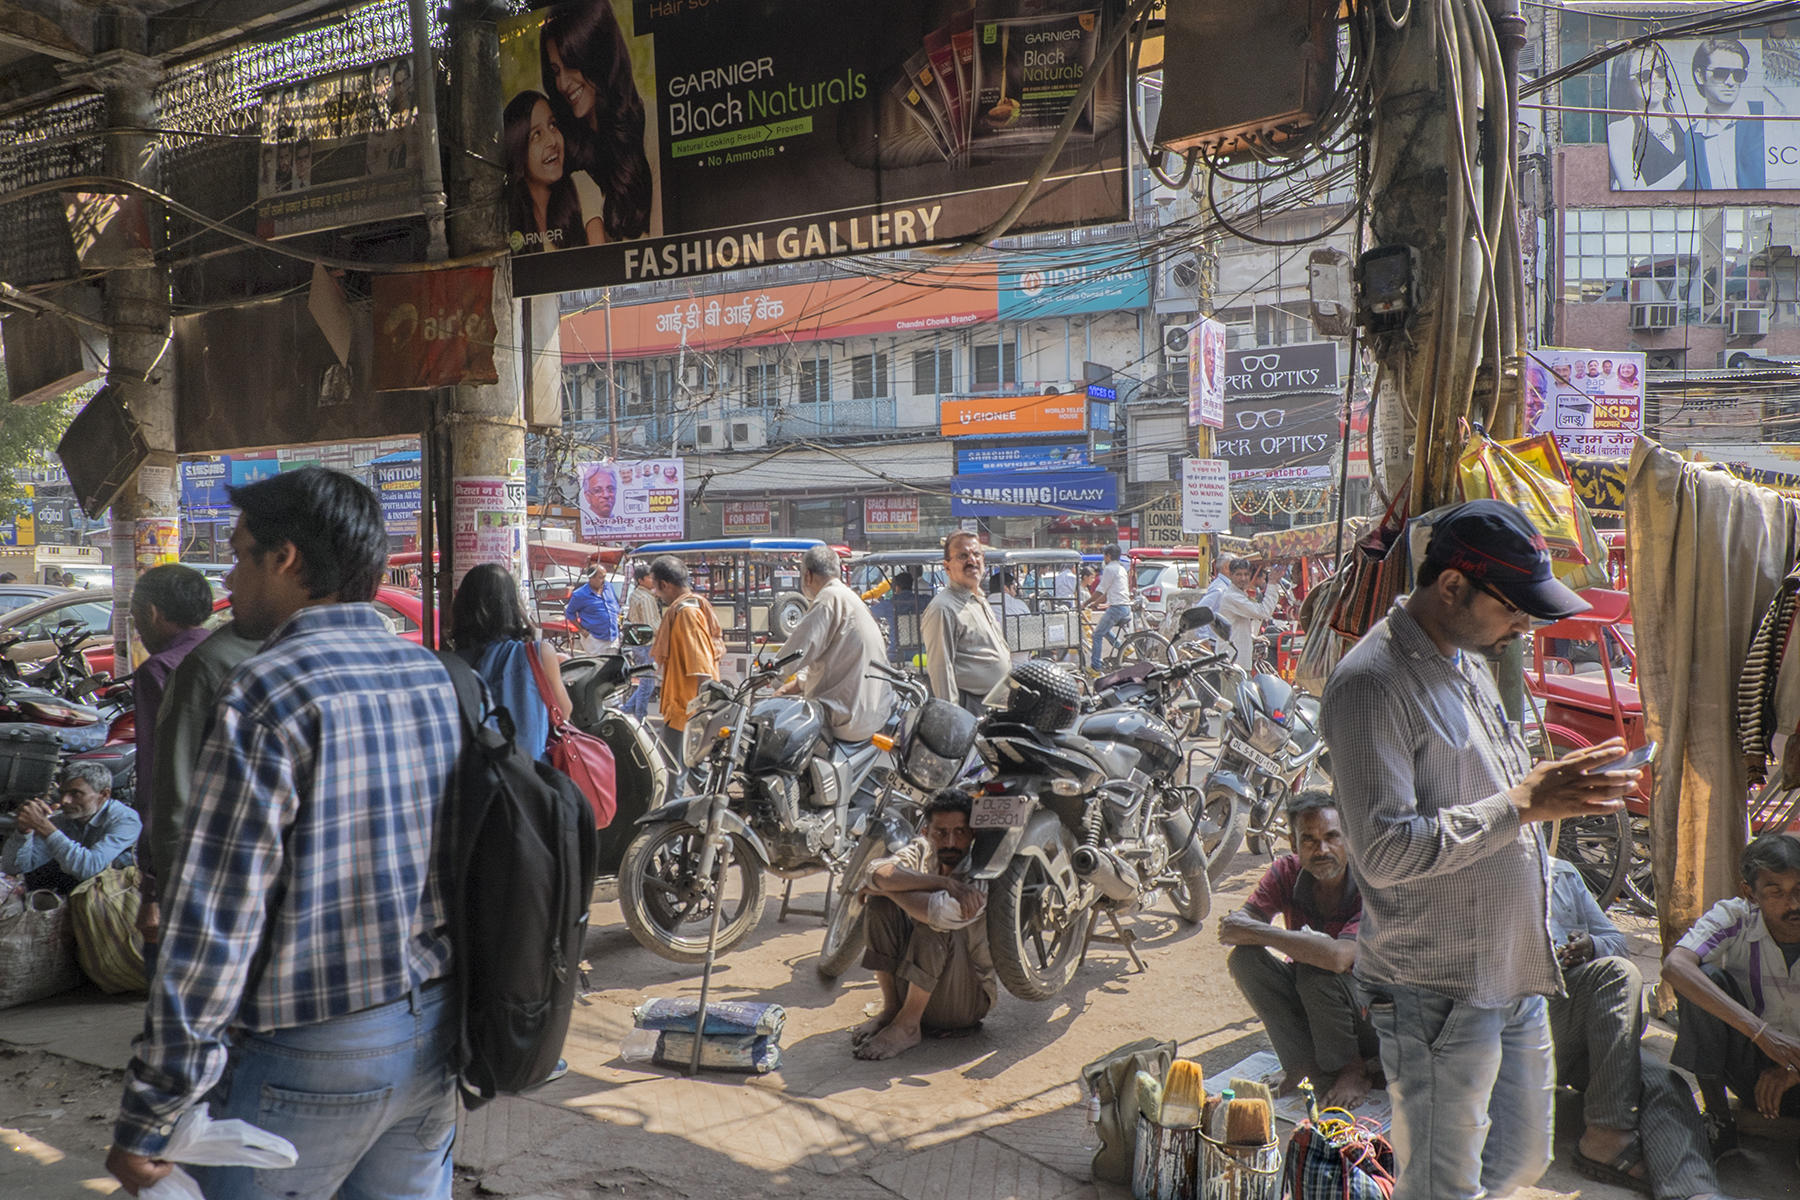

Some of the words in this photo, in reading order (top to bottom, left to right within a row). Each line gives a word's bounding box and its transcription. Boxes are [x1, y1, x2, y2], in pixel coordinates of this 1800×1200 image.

[1025, 29, 1080, 44] GARNIER
[1024, 48, 1065, 67] Black
[669, 56, 774, 97] GARNIER
[1023, 63, 1084, 81] Naturals
[669, 92, 743, 136] Black
[748, 67, 867, 121] Naturals
[676, 141, 702, 153] Natural
[704, 134, 736, 149] Looking
[736, 129, 762, 144] Result
[776, 122, 804, 135] Proven
[707, 155, 722, 168] No
[725, 146, 775, 164] Ammonia
[1768, 146, 1798, 165] SC
[509, 228, 563, 248] GARNIER
[624, 230, 765, 280] FASHION
[776, 205, 942, 262] GALLERY
[656, 304, 683, 334] आई
[685, 302, 701, 329] डी
[704, 300, 722, 326] बी
[723, 296, 753, 325] आई
[754, 294, 785, 320] बैंक
[896, 319, 927, 330] Chandni
[927, 316, 950, 328] Chowk
[951, 313, 977, 325] Branch
[1261, 368, 1320, 388] OPTICS
[973, 410, 1017, 422] GIONEE
[1595, 405, 1630, 418] MCD
[1261, 433, 1328, 455] OPTICS
[968, 450, 1020, 462] SAMSUNG
[185, 463, 226, 476] SAMSUNG
[487, 496, 504, 505] OPEN
[649, 495, 673, 505] MCD
[960, 486, 1051, 505] SAMSUNG
[1059, 488, 1105, 501] GALAXY
[38, 504, 64, 524] digital
[728, 514, 745, 525] FOR
[745, 512, 766, 524] RENT
[871, 511, 888, 522] FOR
[890, 510, 913, 522] RENT
[1232, 740, 1242, 752] DL
[887, 772, 898, 786] DL
[974, 813, 1019, 826] BP2501
